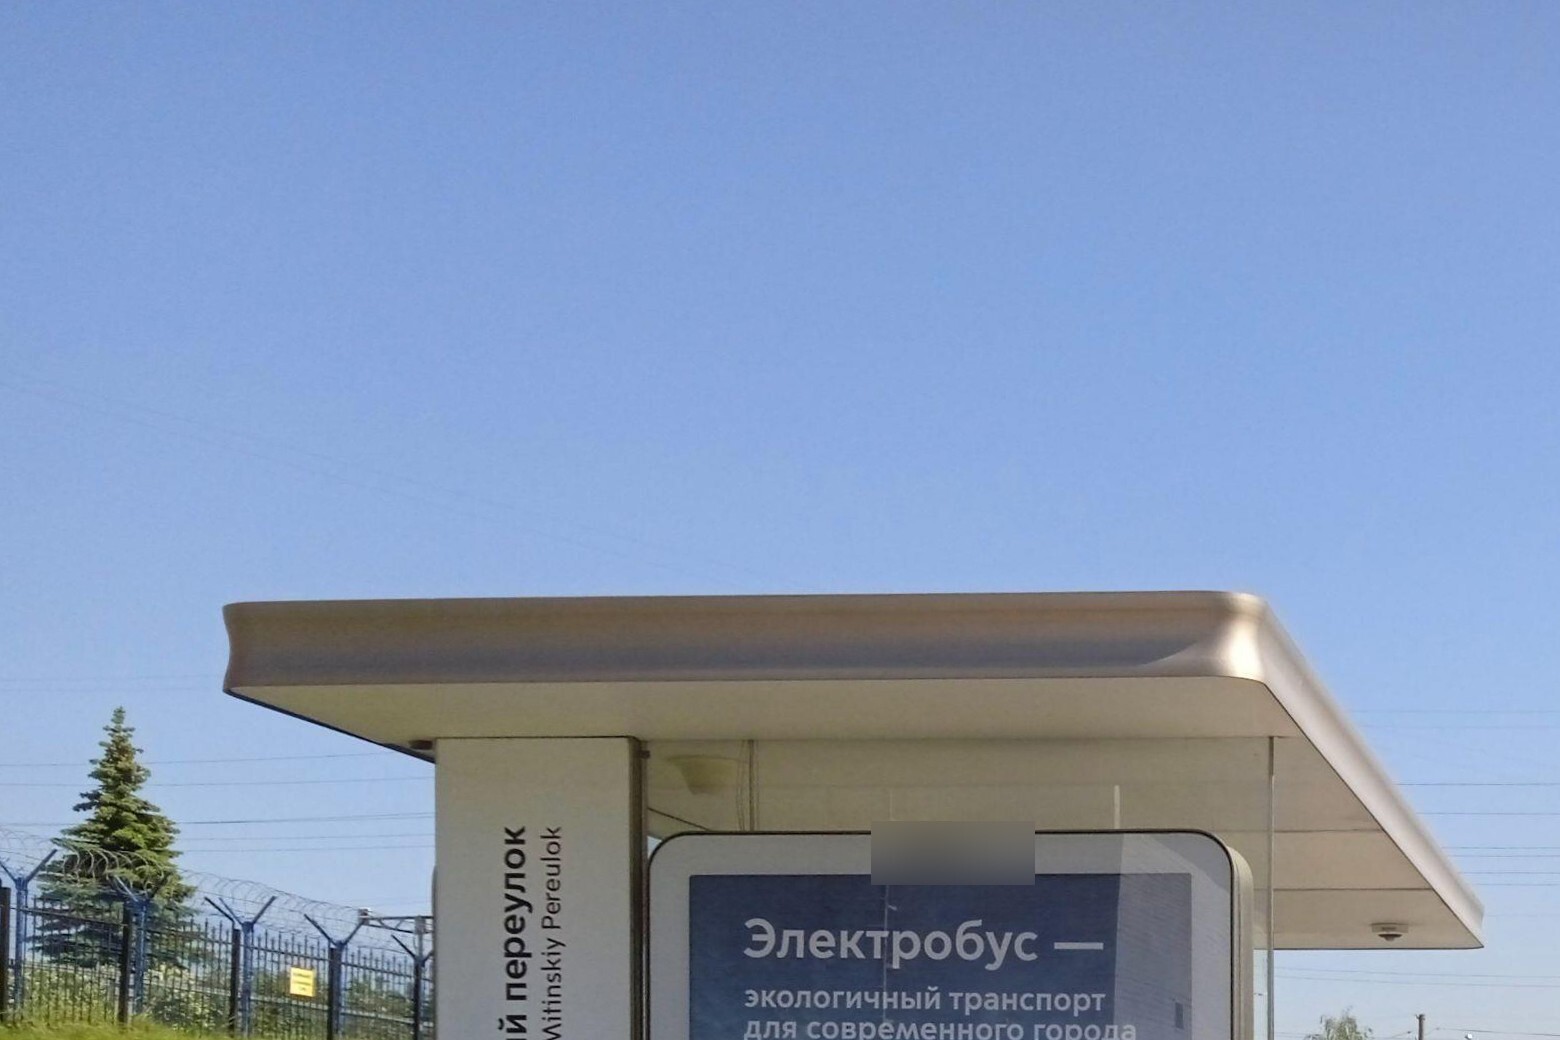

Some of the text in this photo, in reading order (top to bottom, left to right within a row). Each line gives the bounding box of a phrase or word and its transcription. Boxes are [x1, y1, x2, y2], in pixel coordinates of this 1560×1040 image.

[503, 825, 534, 1001] переулок
[539, 825, 563, 931] Pereulok
[743, 917, 1039, 971] Электробус
[743, 985, 1107, 1016] экологичный транспорт
